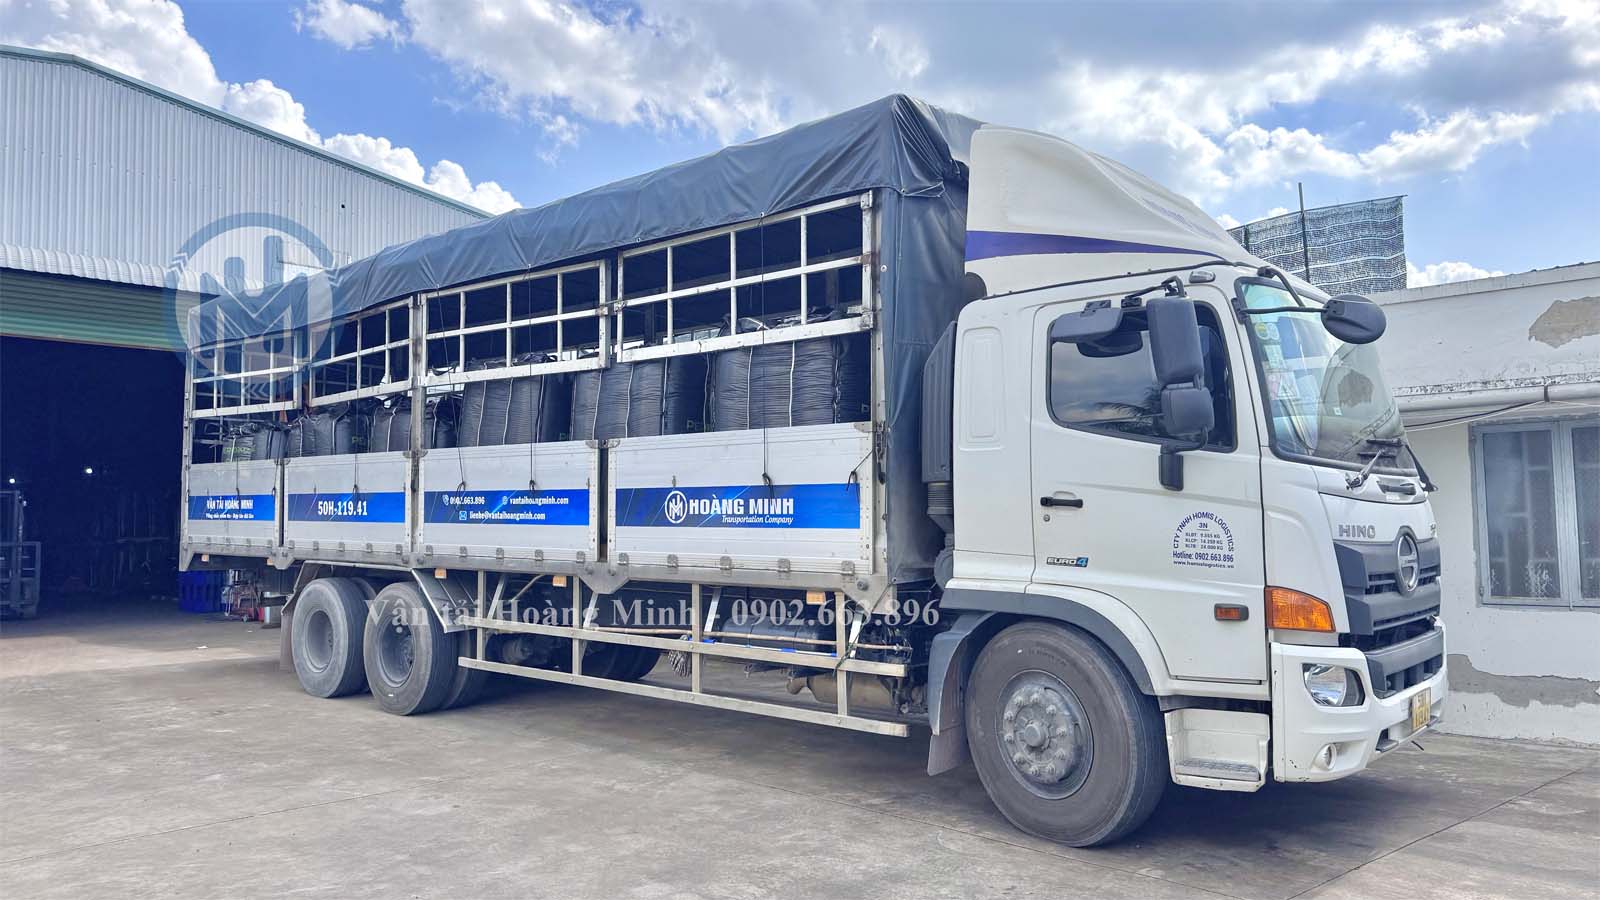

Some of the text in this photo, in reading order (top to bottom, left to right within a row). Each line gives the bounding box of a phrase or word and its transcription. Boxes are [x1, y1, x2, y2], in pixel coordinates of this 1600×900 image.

[318, 500, 368, 516] 50H-119.41
[689, 494, 794, 515] HOÀNG MINH
[722, 515, 794, 526] Transportation Company
[1173, 511, 1235, 552] CTY TNHH HOMIS LOGISTICS
[1338, 524, 1376, 539] HINO
[1173, 550, 1234, 562] Hotline: 0902.663.896
